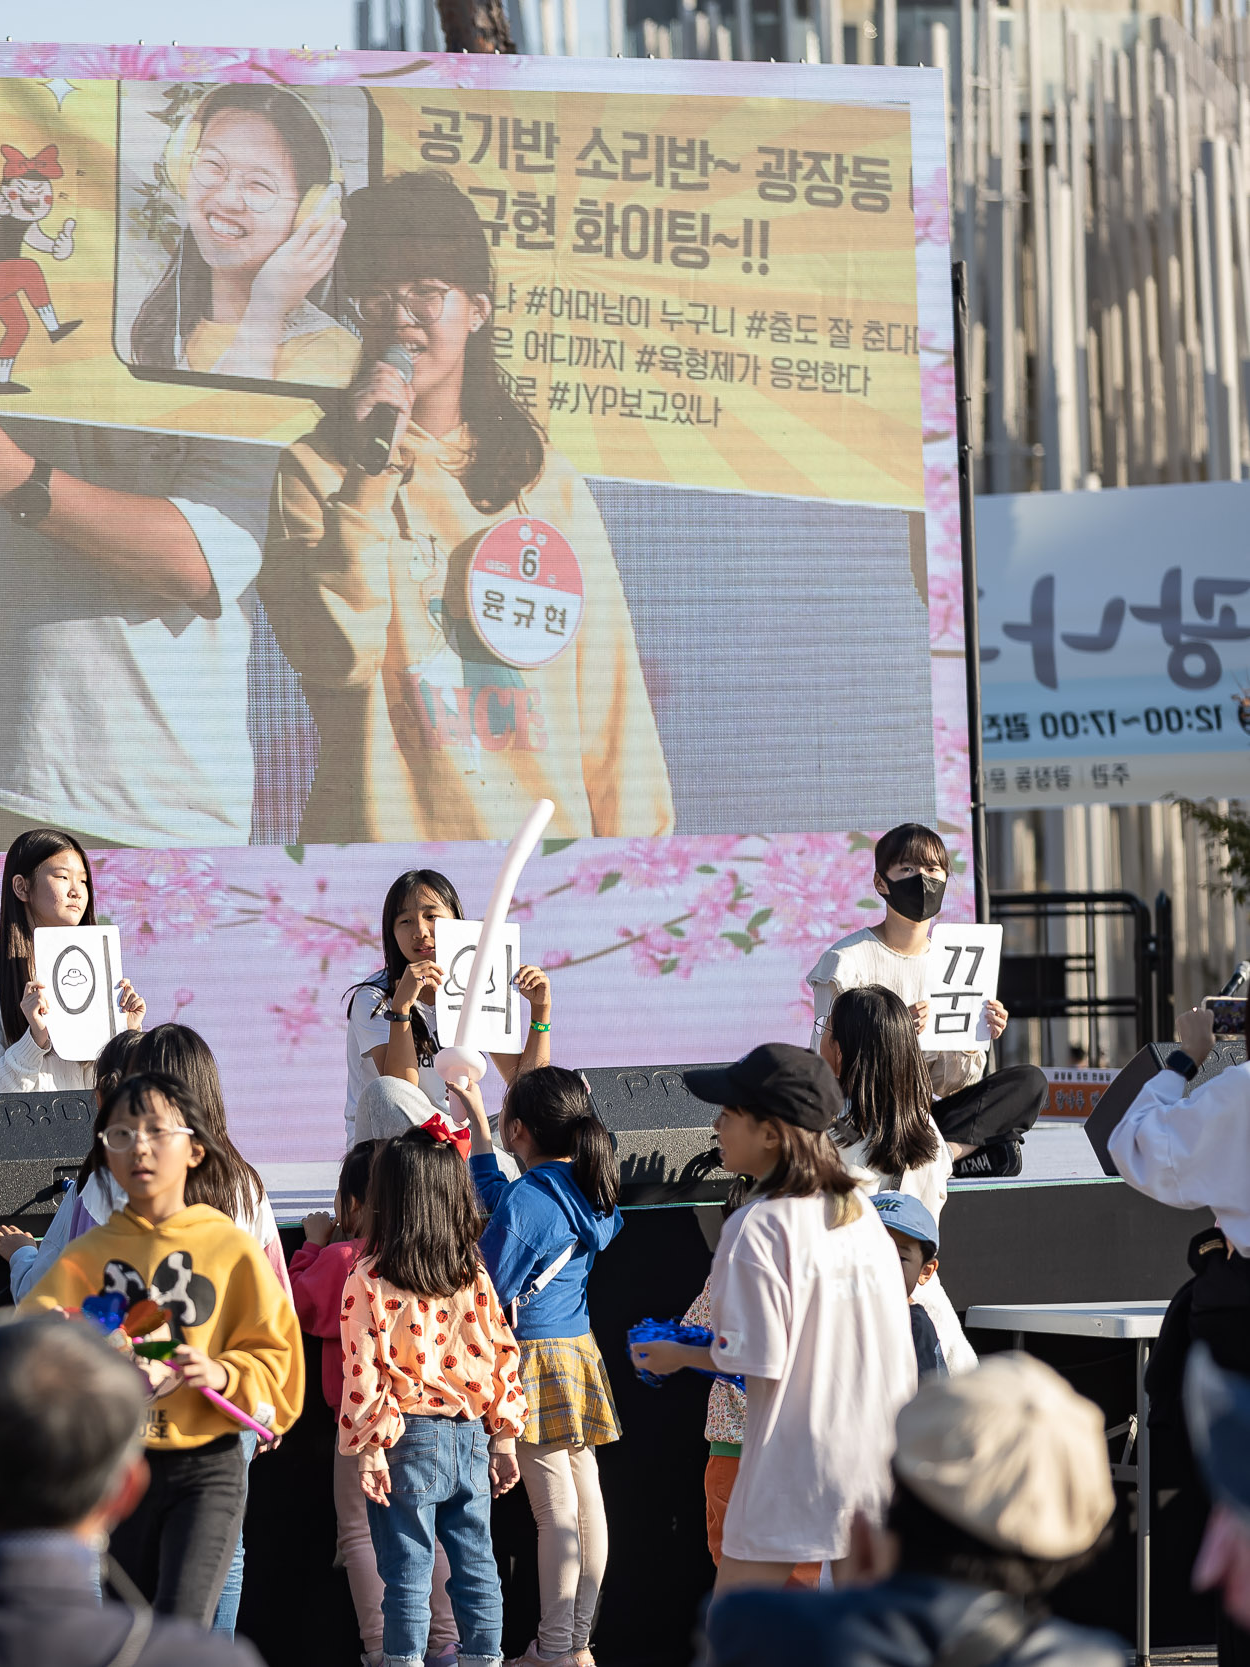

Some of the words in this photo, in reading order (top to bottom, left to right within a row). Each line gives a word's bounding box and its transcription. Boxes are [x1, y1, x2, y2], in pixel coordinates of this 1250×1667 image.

[418, 105, 560, 173] 공기반
[574, 127, 742, 192] 소리반~
[754, 145, 892, 214] 광장동
[572, 199, 770, 276] 화이팅~!!
[526, 285, 651, 329] #어머님이
[659, 300, 736, 338] 누구니
[743, 311, 819, 346] #춤도
[827, 316, 852, 349] 잘
[525, 328, 625, 372] 어디까지
[635, 342, 762, 386] #육형제가
[770, 357, 871, 397] 응원한다
[548, 380, 722, 428] #JYP보고있나
[521, 550, 537, 577] 6
[482, 589, 567, 636] 윤규현
[52, 935, 116, 1037] 이
[930, 945, 985, 1034] 꿈
